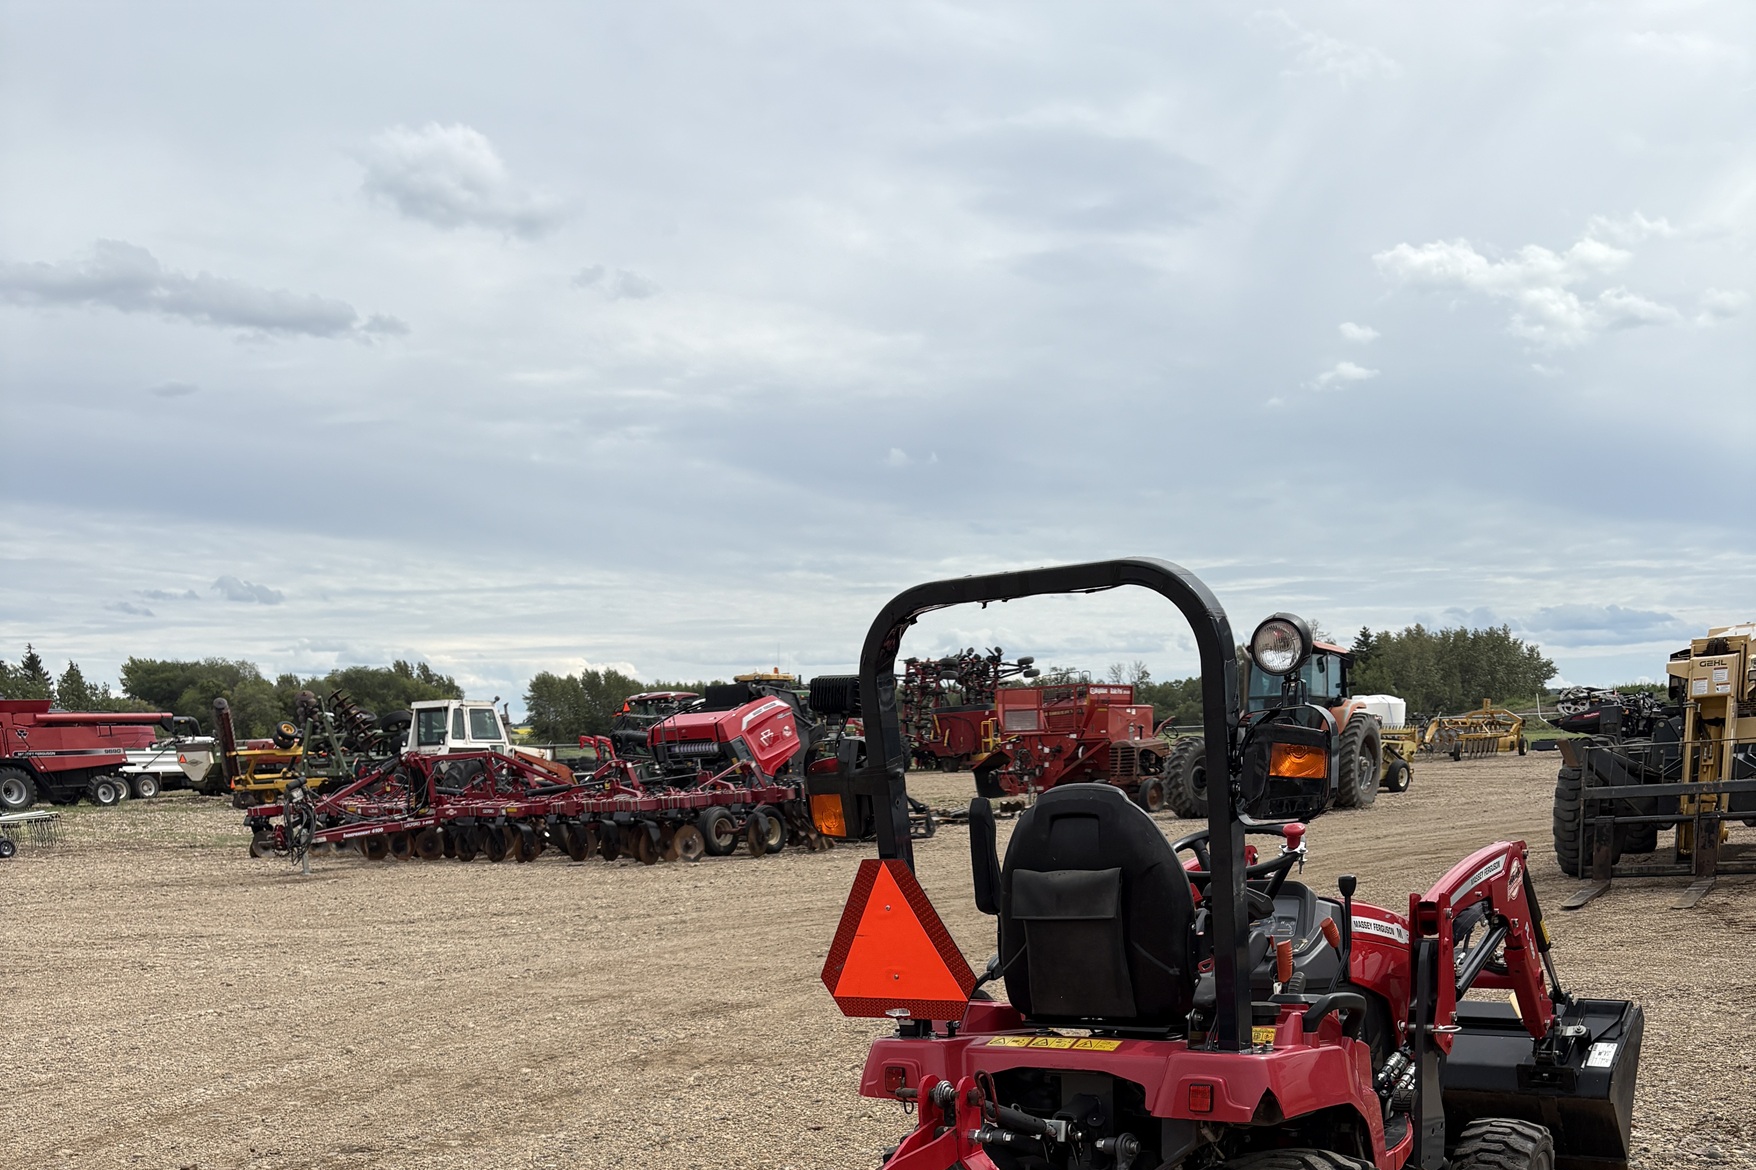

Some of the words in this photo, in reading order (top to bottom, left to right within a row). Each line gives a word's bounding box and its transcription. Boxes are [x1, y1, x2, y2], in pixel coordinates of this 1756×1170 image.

[1699, 660, 1728, 668] GEHL
[1353, 920, 1373, 930] MASSEY
[1372, 922, 1395, 936] FERGUSON
